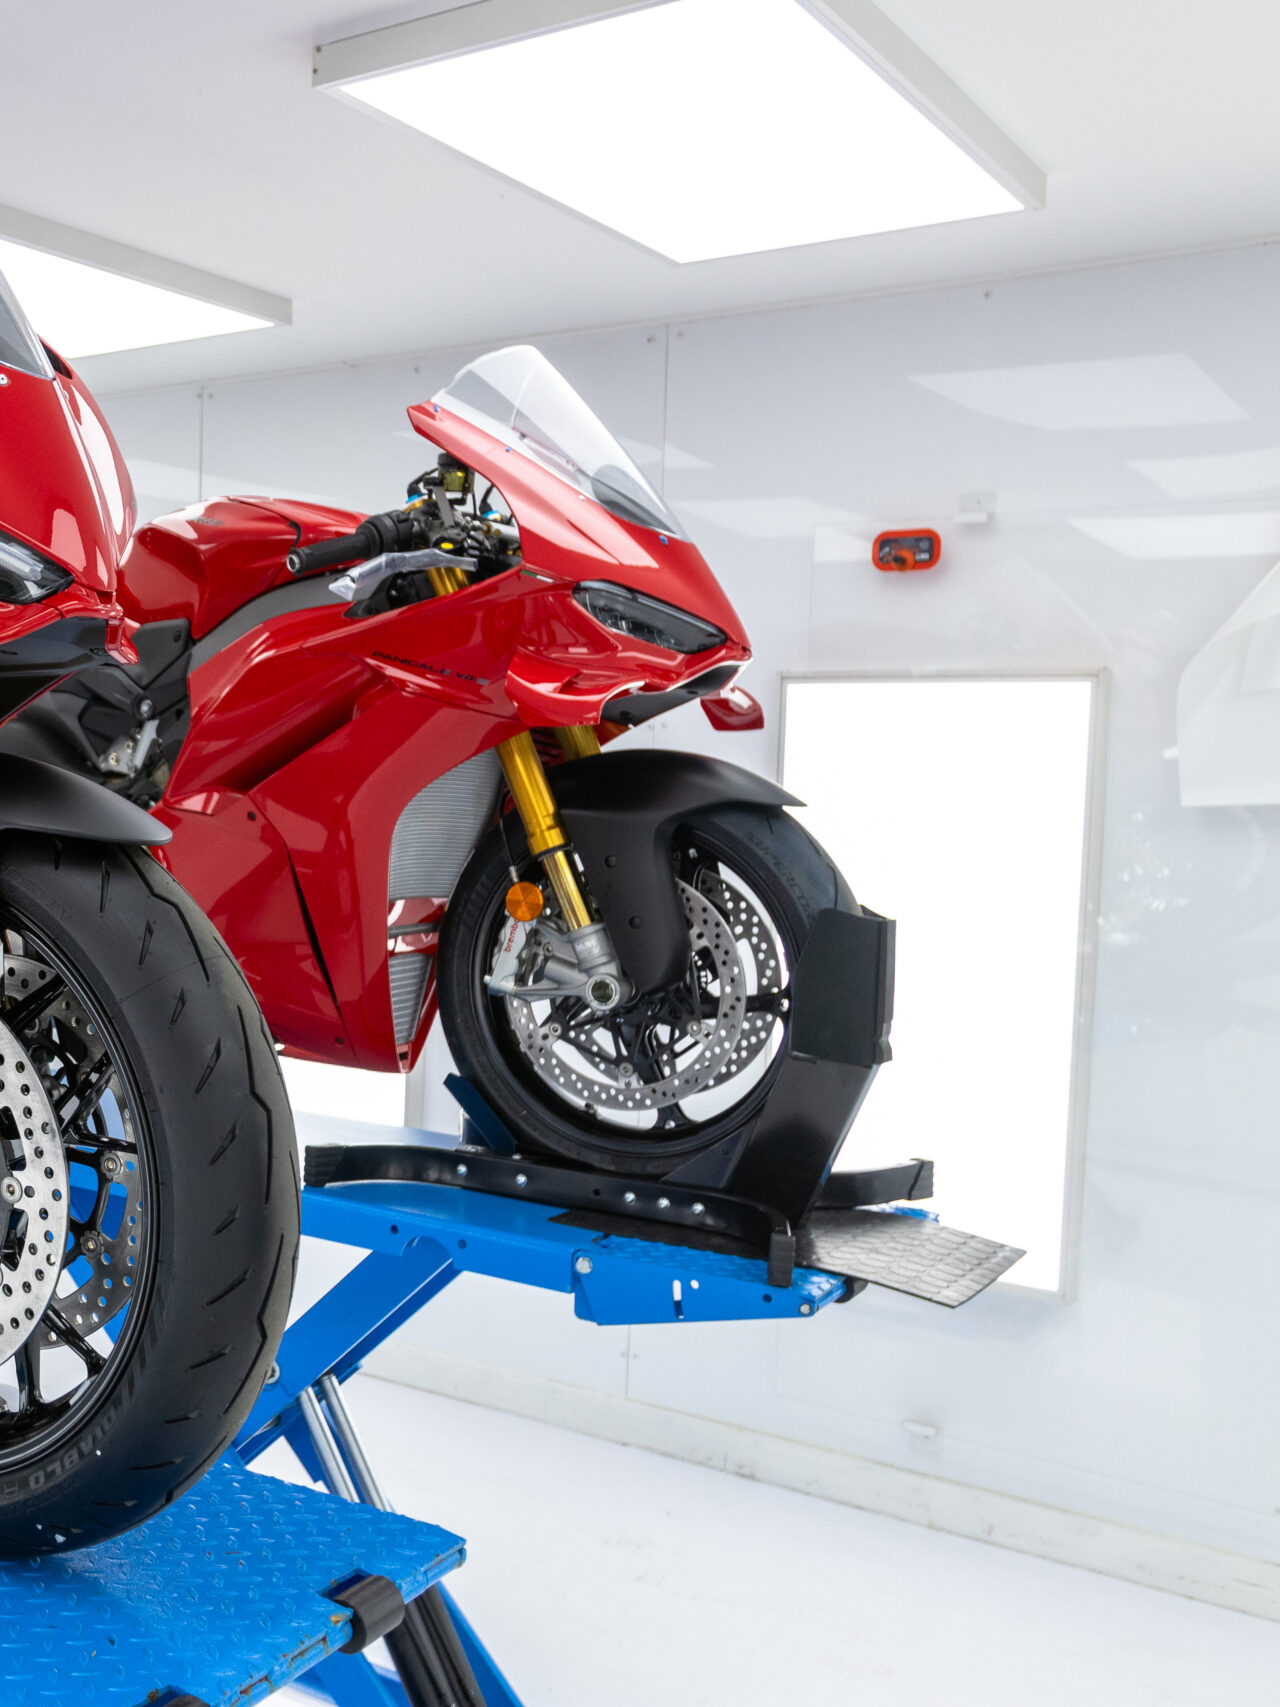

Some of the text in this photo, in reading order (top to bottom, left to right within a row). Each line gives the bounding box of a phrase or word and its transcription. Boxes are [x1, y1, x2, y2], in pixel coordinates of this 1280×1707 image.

[372, 650, 453, 676] PANIGALE
[456, 671, 475, 682] V4
[28, 1407, 120, 1491] DIABLO
